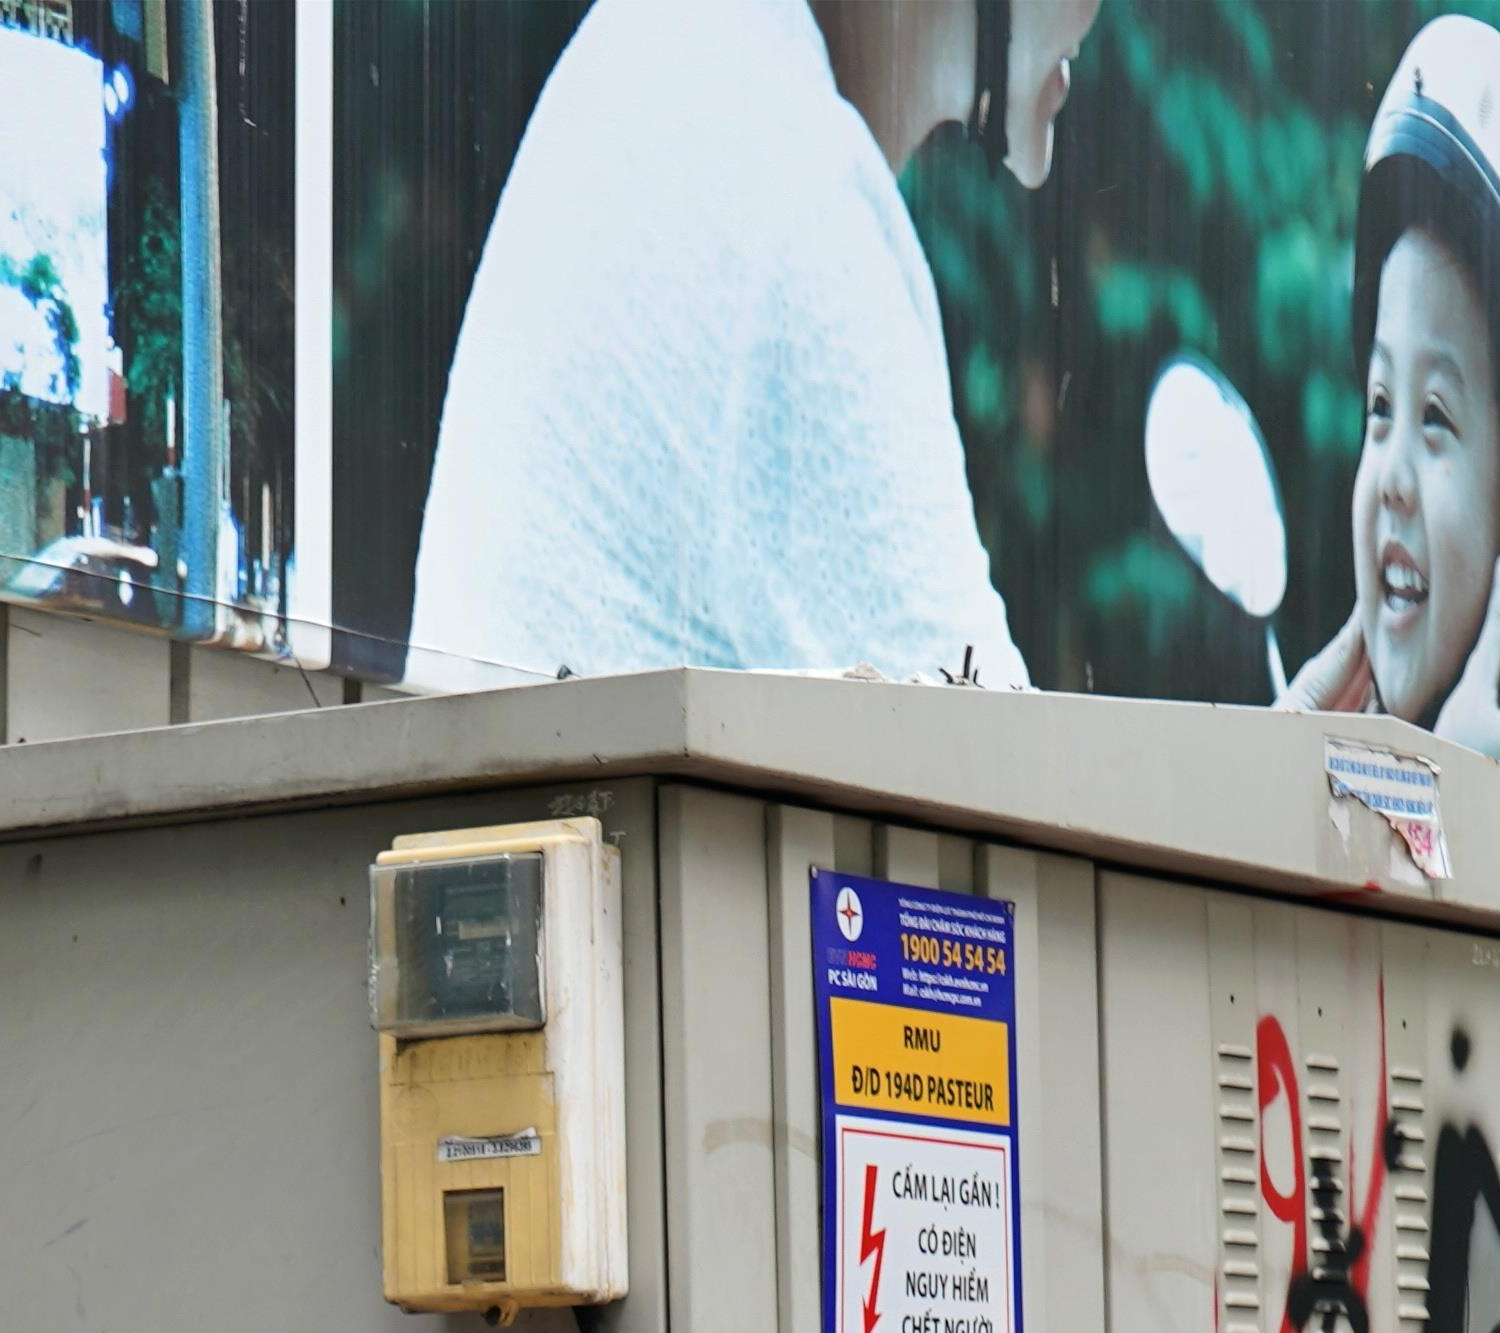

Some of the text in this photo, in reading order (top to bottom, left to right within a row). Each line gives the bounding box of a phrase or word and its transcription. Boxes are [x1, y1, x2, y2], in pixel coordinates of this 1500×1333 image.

[901, 932, 1006, 976] 1900 54 54 54
[903, 1024, 941, 1053] RMU
[885, 1071, 924, 1102] 194D
[928, 1075, 995, 1112] PASTEUR
[893, 1162, 928, 1200] CẤM
[932, 1176, 955, 1212] LẠI
[918, 1223, 977, 1266] CÓ ĐIỆN
[906, 1269, 989, 1303] NGUY HIỂM
